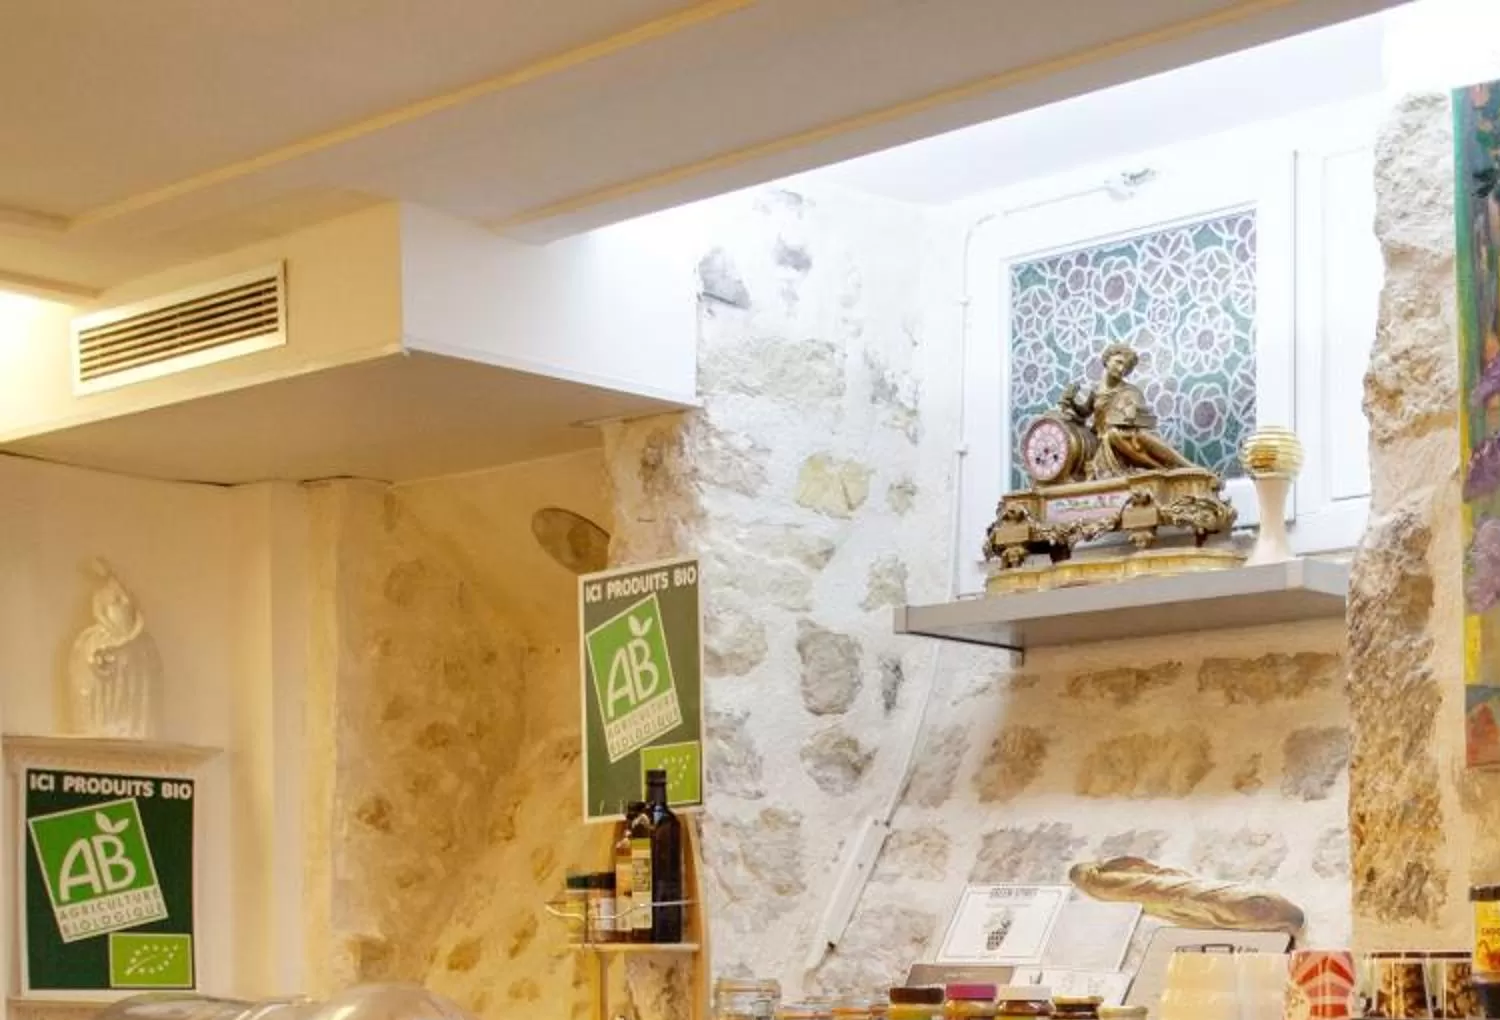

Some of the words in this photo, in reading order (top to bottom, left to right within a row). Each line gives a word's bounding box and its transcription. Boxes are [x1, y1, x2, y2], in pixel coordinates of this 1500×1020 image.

[585, 583, 601, 603] ICI
[607, 571, 669, 600] PRODUITS
[673, 565, 697, 587] BIO
[607, 638, 659, 718] AB
[29, 774, 54, 792] ICI
[63, 776, 154, 797] PRODUITS
[161, 782, 193, 799] BIO
[59, 834, 136, 902] AB
[59, 887, 161, 922] AGRICULTURE
[61, 902, 163, 936] BIOLOGIQUE
